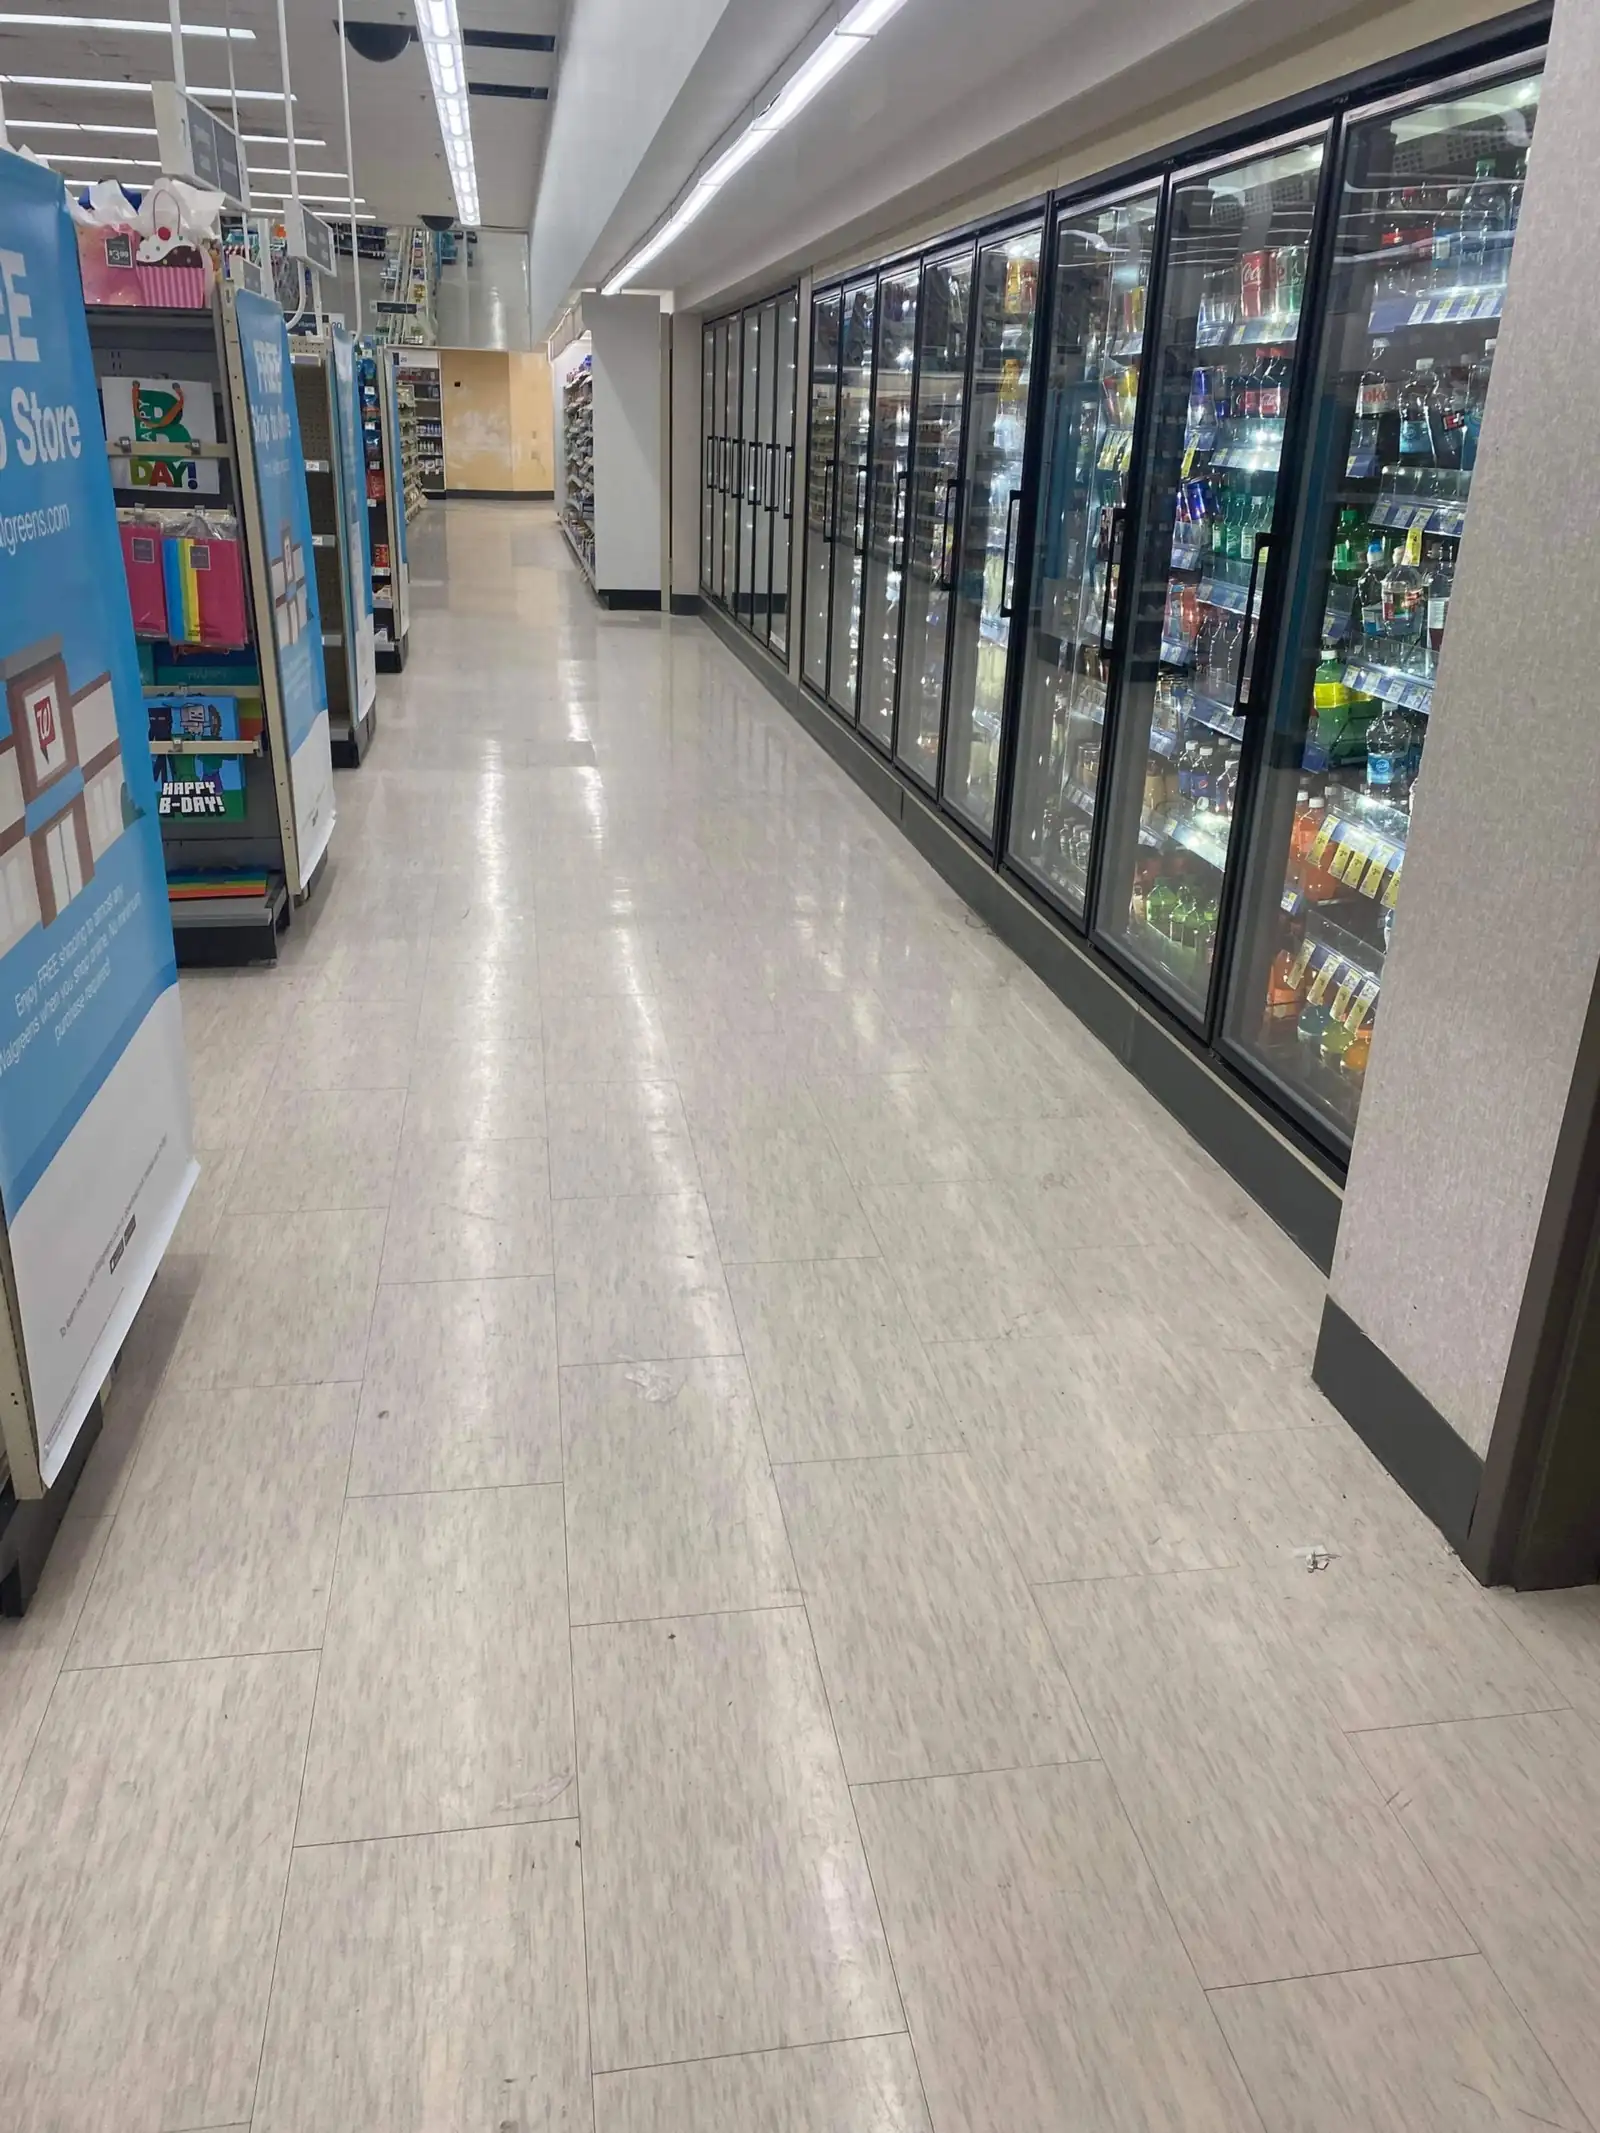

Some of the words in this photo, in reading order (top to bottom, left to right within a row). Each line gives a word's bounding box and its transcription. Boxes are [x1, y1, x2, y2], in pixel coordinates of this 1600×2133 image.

[11, 387, 82, 466] Store
[138, 400, 152, 442] APPY
[130, 459, 198, 490] DAY!
[159, 796, 226, 814] B-DAY!
[162, 781, 216, 796] HAPPY
[37, 953, 60, 991] FREE
